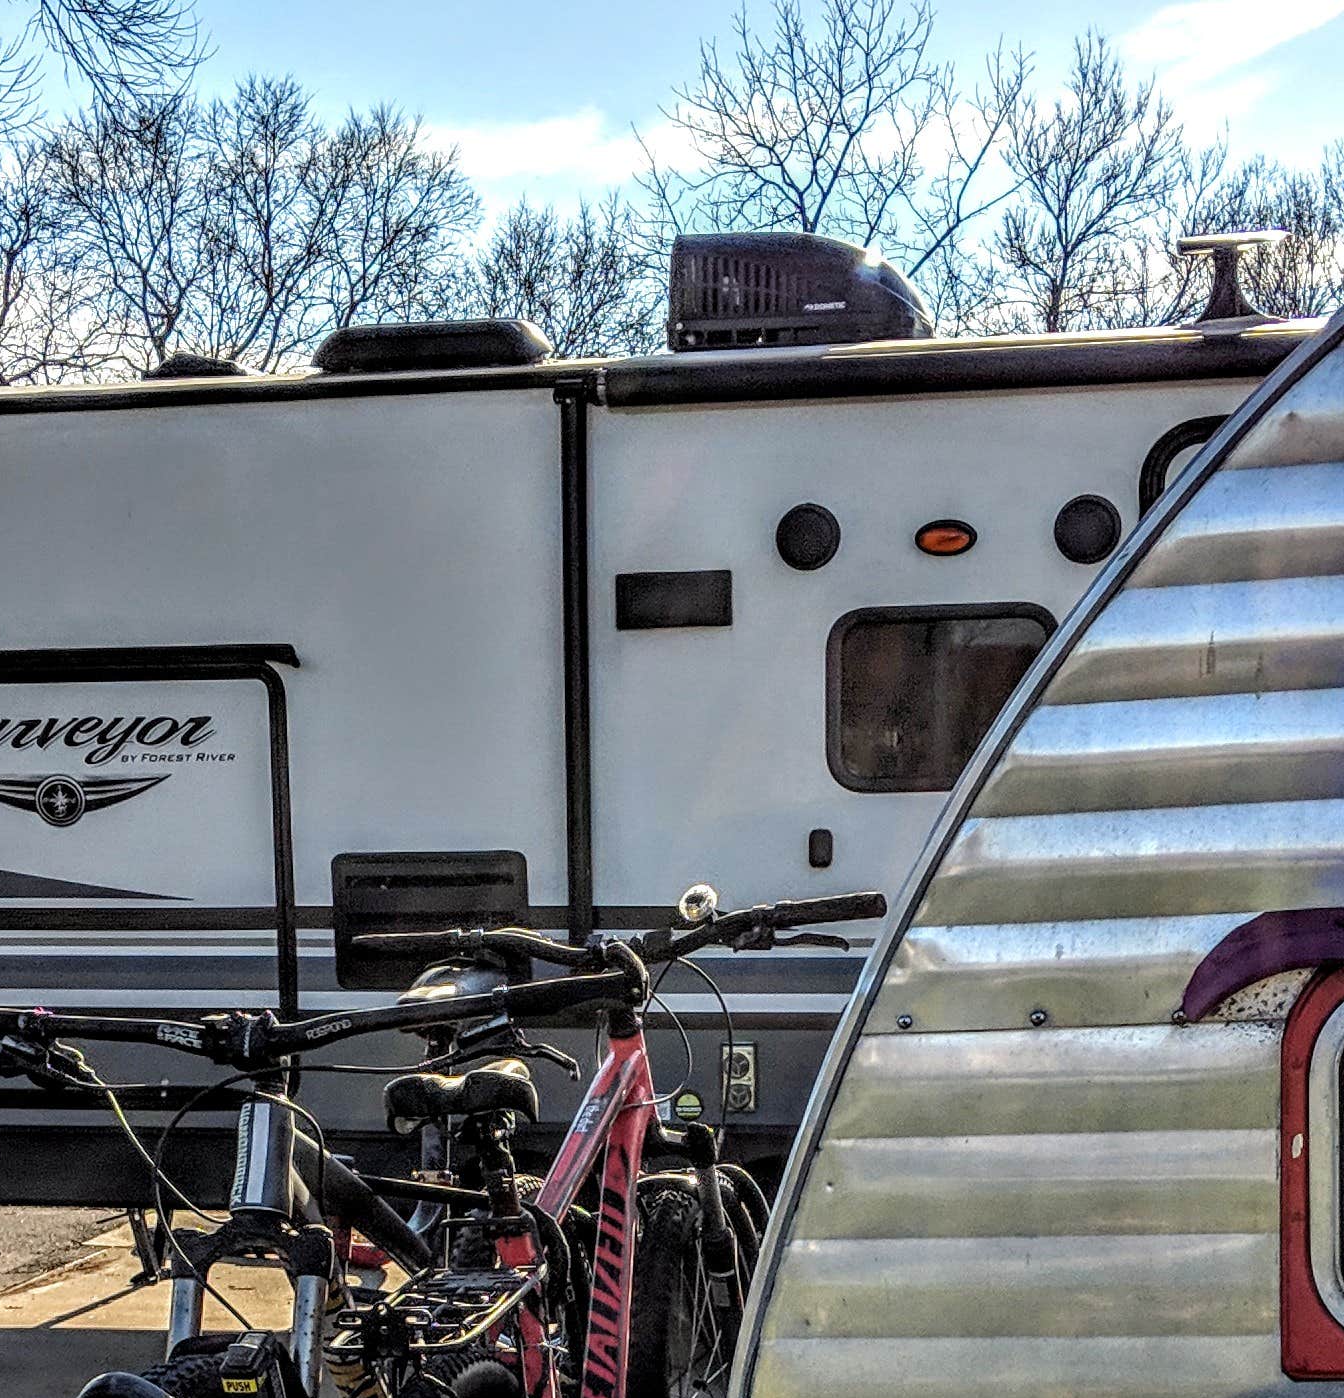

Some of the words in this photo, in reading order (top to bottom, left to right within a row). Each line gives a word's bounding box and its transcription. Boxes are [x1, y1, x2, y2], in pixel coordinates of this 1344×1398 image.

[141, 753, 193, 763] FOREST
[196, 752, 236, 762] RIVER
[226, 1381, 252, 1392] PUSH
